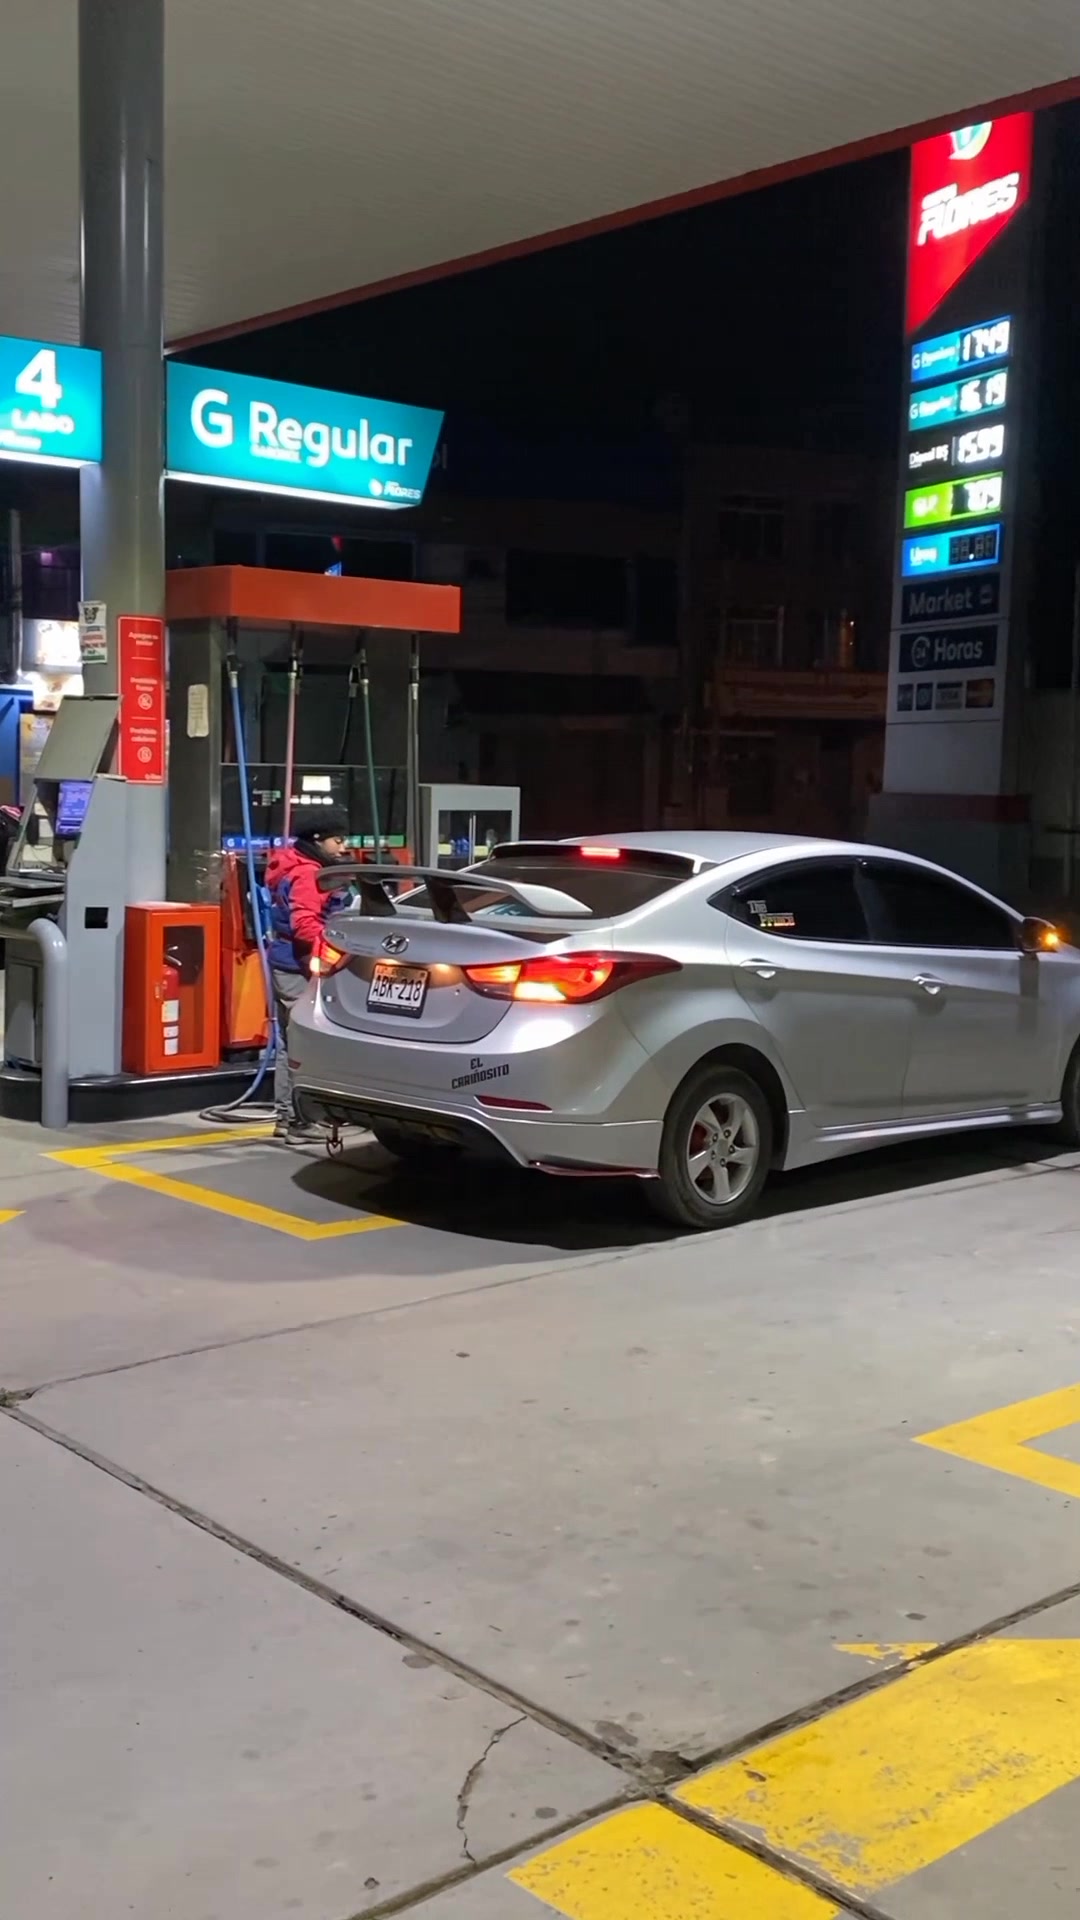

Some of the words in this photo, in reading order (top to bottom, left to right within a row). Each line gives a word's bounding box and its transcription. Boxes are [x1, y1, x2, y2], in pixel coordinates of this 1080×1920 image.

[912, 354, 920, 369] G
[15, 349, 63, 409] 4
[910, 403, 918, 419] G
[190, 388, 233, 449] G
[249, 400, 413, 468] Regular
[910, 586, 974, 616] Market
[934, 638, 983, 662] Horas
[372, 975, 422, 1002] ABK-218
[470, 1057, 483, 1070] EL
